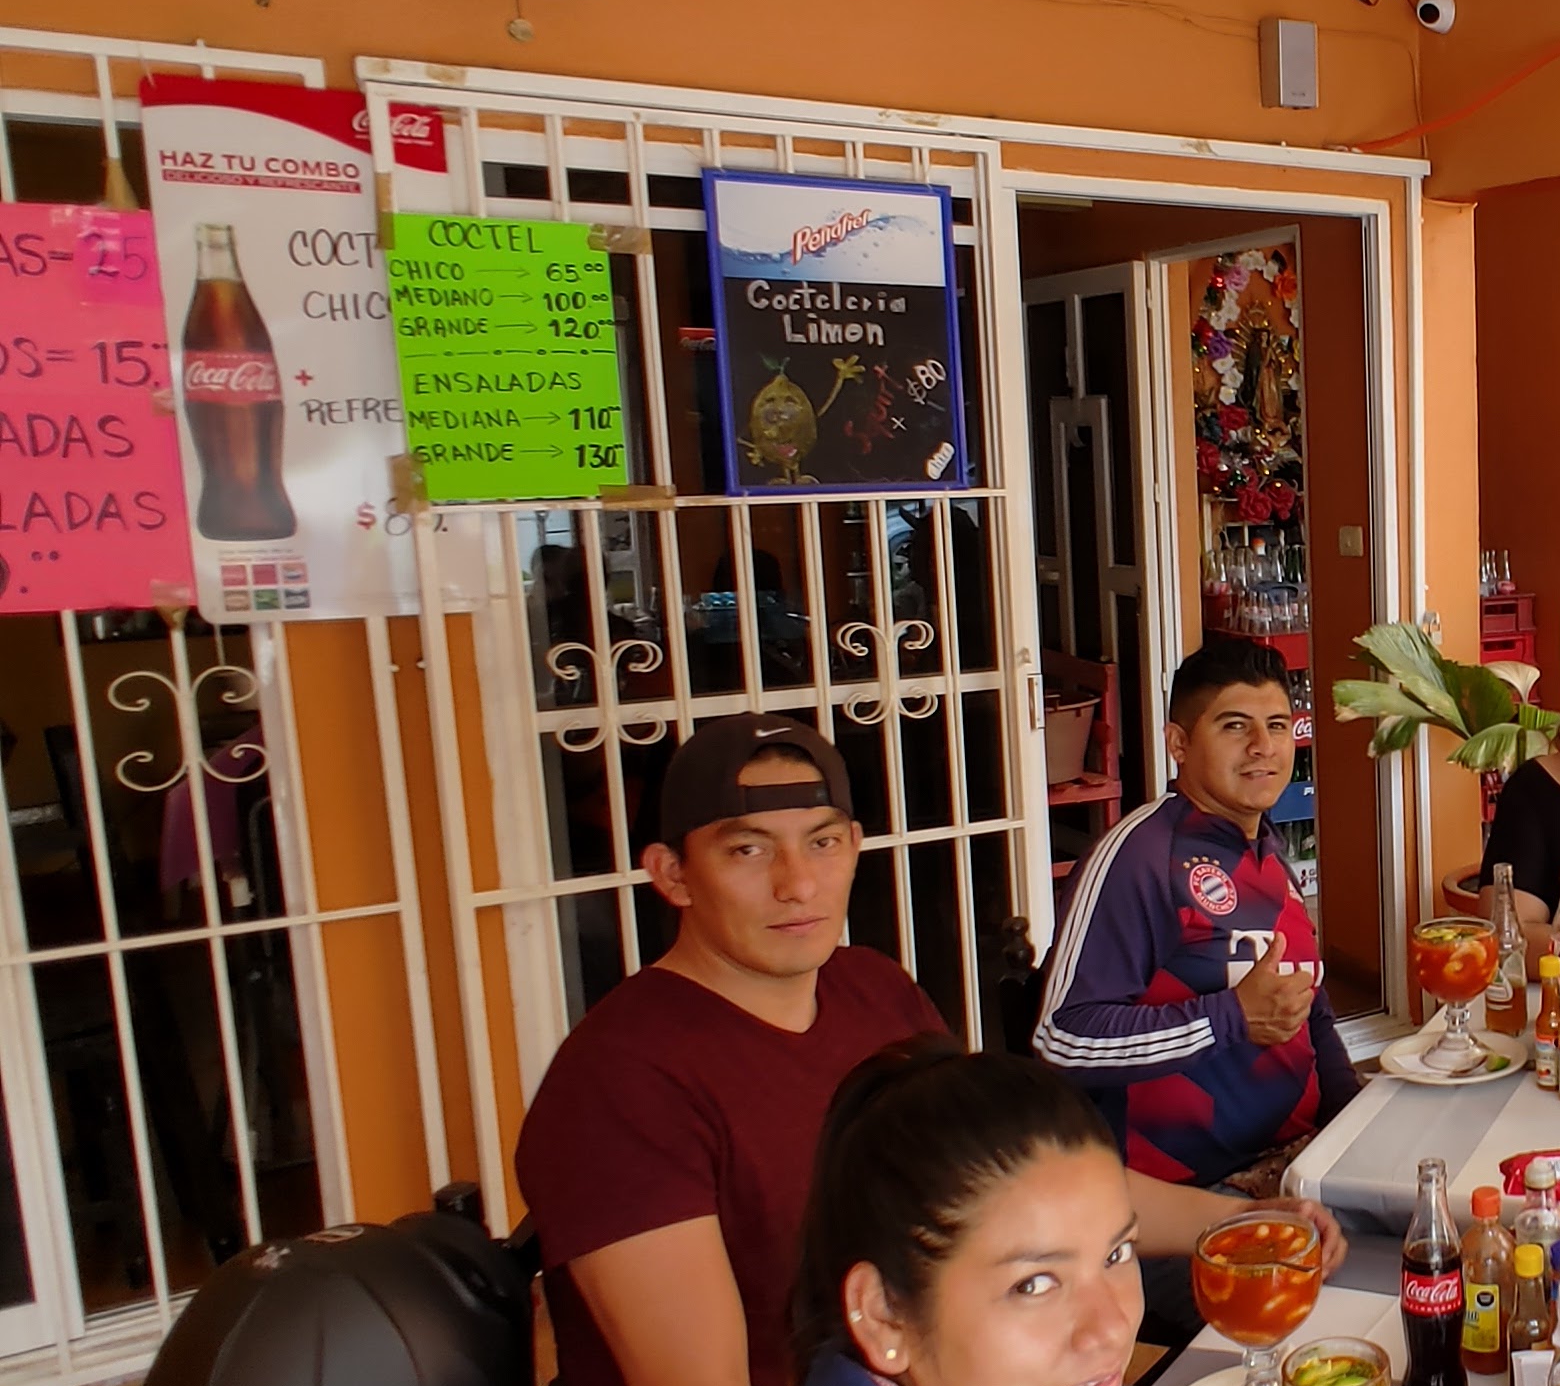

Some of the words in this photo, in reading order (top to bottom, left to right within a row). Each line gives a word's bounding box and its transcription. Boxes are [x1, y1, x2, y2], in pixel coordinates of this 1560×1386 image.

[159, 150, 215, 169] HAZ
[222, 154, 255, 171] TU
[265, 157, 360, 179] COMBO
[288, 228, 376, 268] COCT
[428, 219, 543, 254] COCTEL
[389, 258, 465, 281] CHICO
[303, 290, 391, 322] CHIC
[394, 283, 494, 307] MEDIANO
[399, 315, 488, 339] GRANDE
[783, 312, 886, 346] Limon
[413, 371, 583, 396] ENSALADAS
[300, 397, 404, 426] REFRE
[408, 409, 522, 431] MEDIANA
[412, 442, 515, 465] GRANDE
